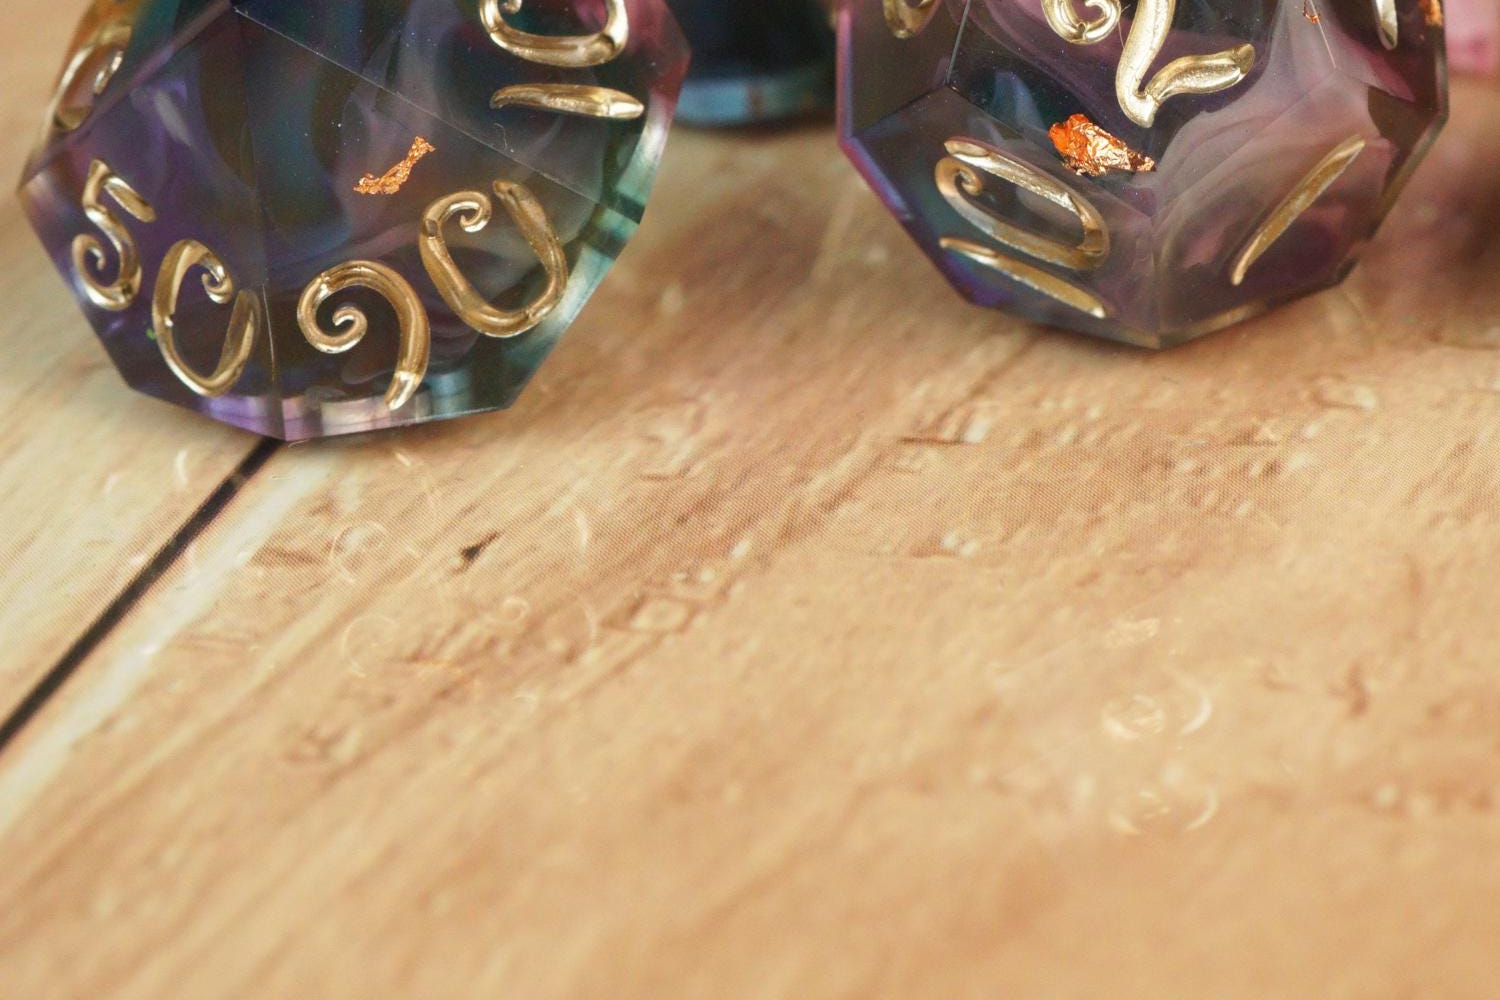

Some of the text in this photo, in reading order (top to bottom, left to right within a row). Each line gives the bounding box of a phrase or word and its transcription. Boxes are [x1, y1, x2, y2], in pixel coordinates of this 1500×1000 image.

[72, 160, 262, 397] 50
[297, 179, 567, 411] 90
[934, 137, 1112, 318] 10
